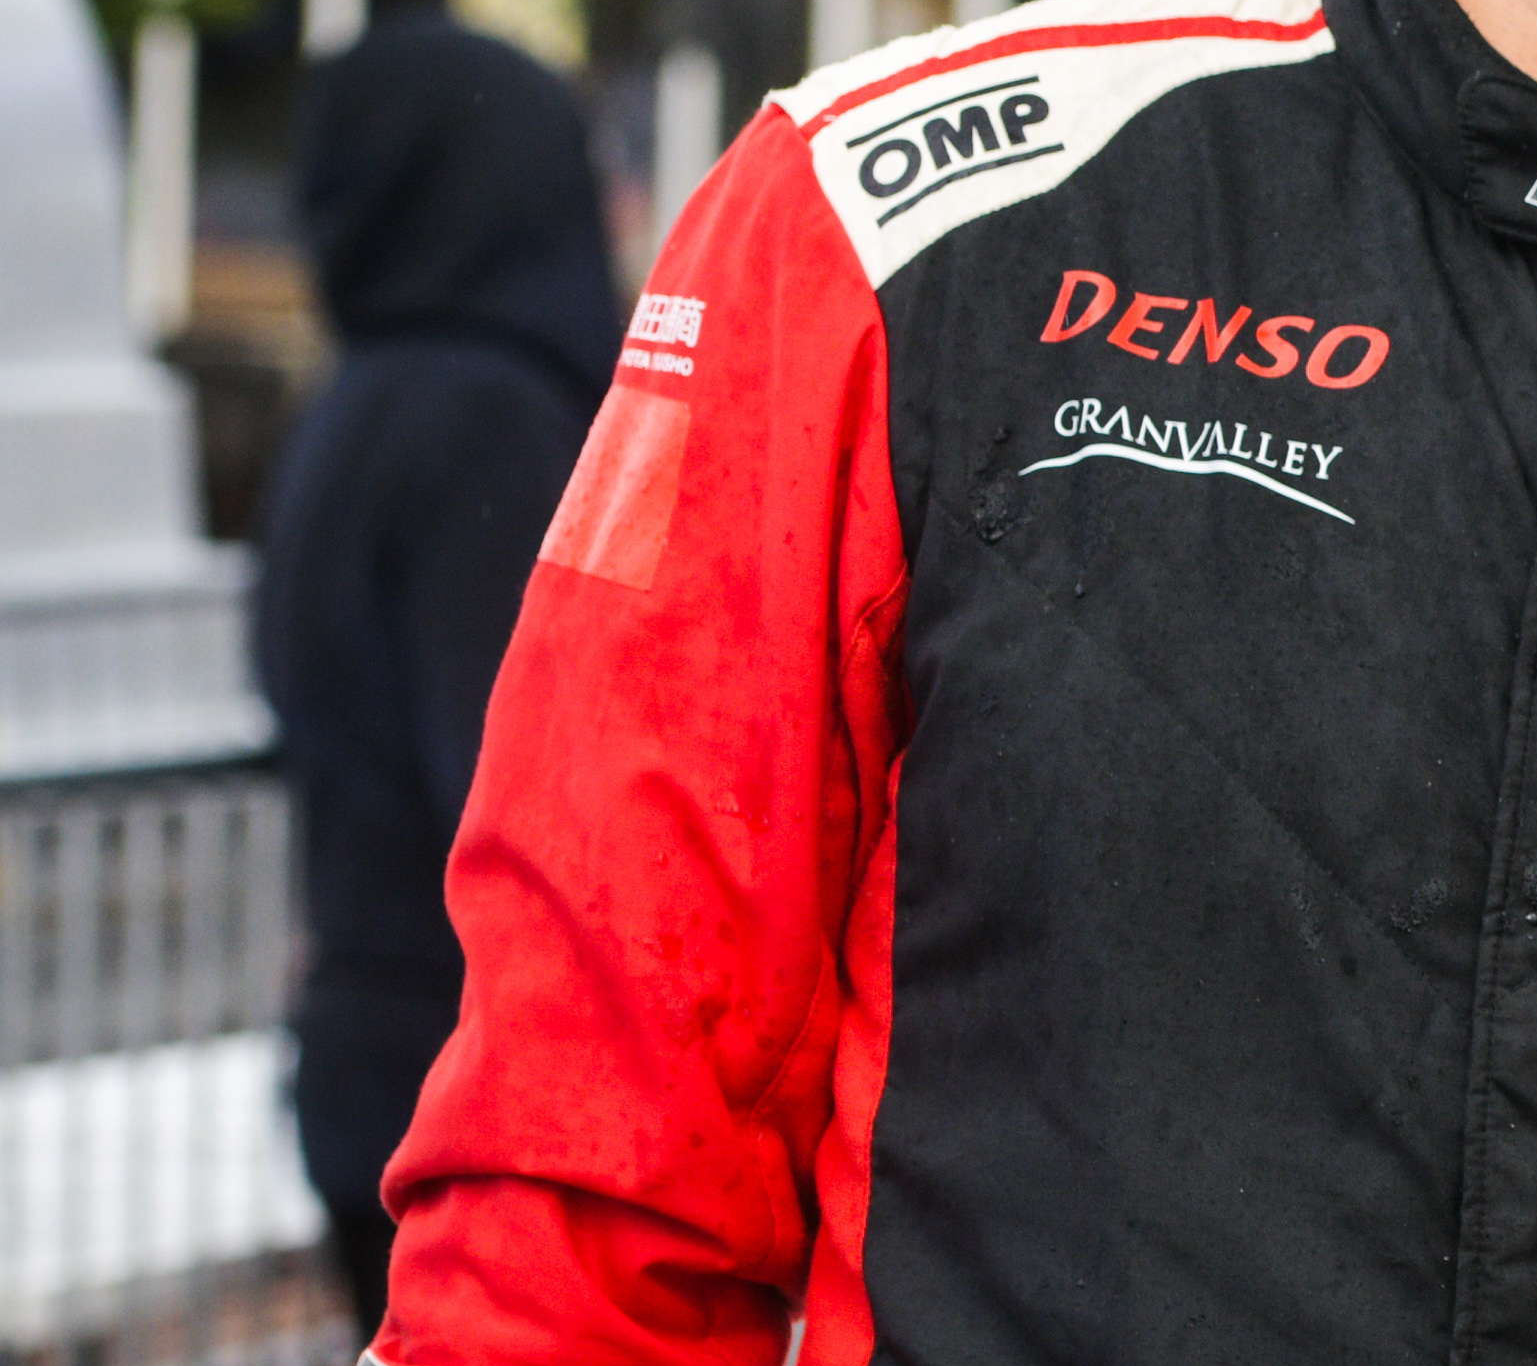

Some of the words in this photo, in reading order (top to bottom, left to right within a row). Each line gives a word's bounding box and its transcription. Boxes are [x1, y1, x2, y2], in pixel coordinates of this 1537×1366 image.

[858, 94, 1052, 199] OMP
[1041, 269, 1391, 390] DENSO
[1055, 397, 1343, 482] GRANVALLEY
